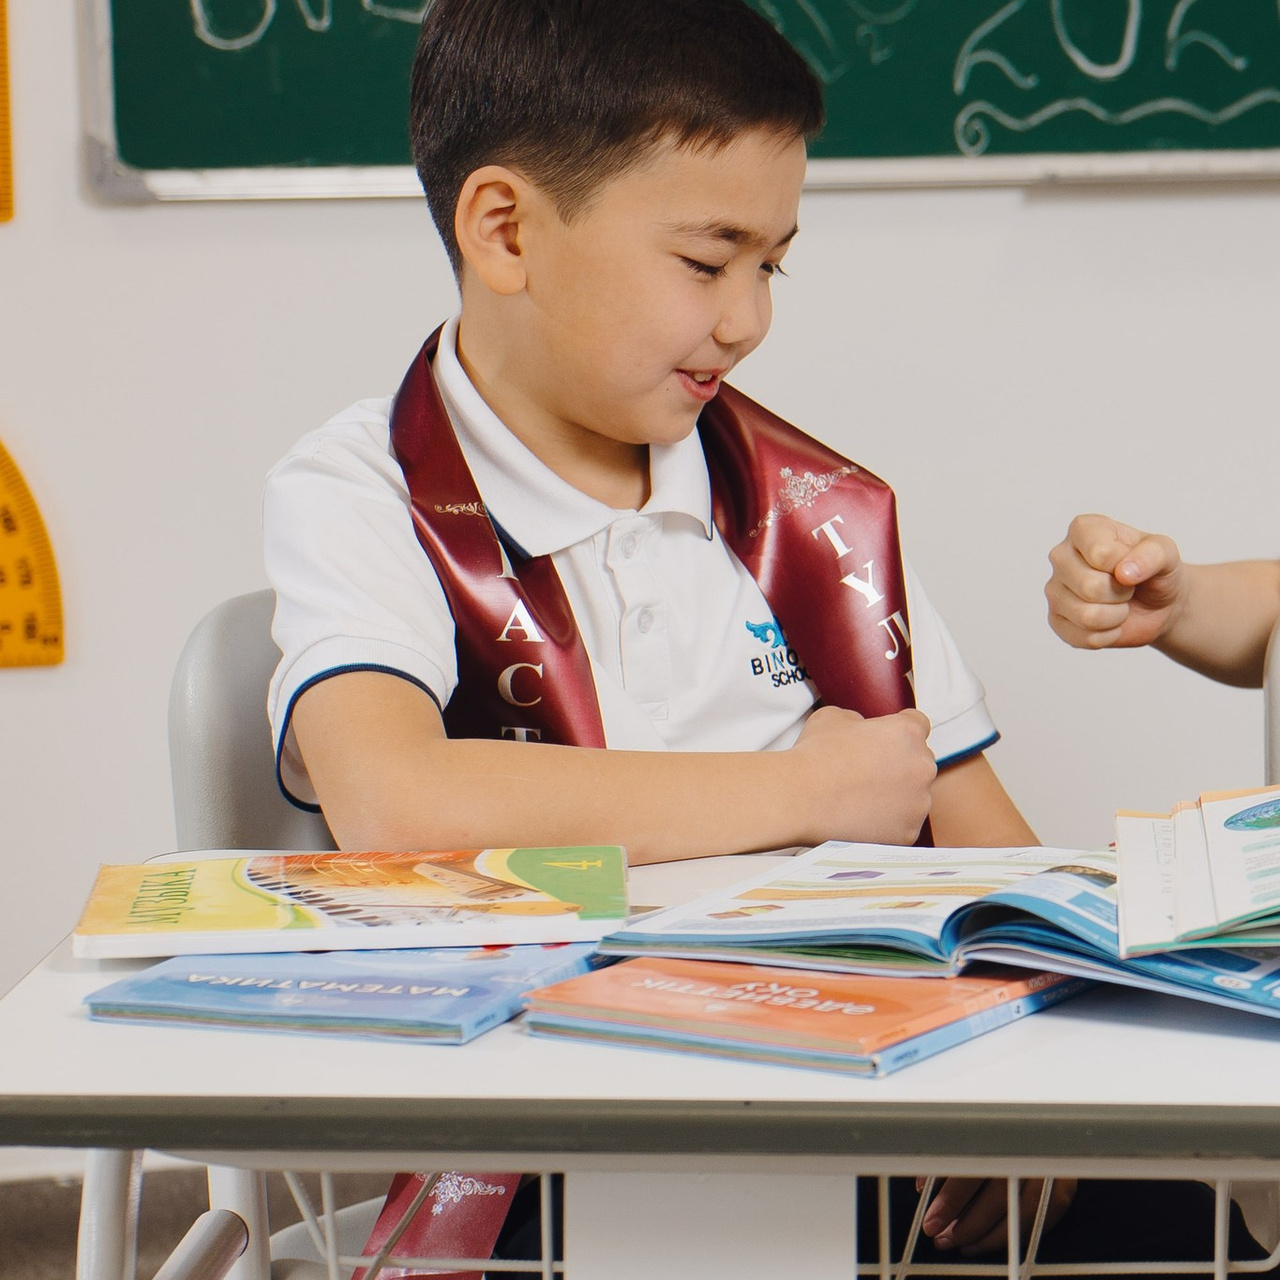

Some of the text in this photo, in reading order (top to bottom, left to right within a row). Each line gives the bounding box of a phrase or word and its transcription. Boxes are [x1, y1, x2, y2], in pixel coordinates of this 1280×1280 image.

[750, 648, 799, 676] BINO
[771, 666, 812, 688] SCHO
[541, 859, 603, 872] 4
[126, 867, 198, 926] МУЗЫКА
[186, 973, 471, 999] МАТЕМАТИКА
